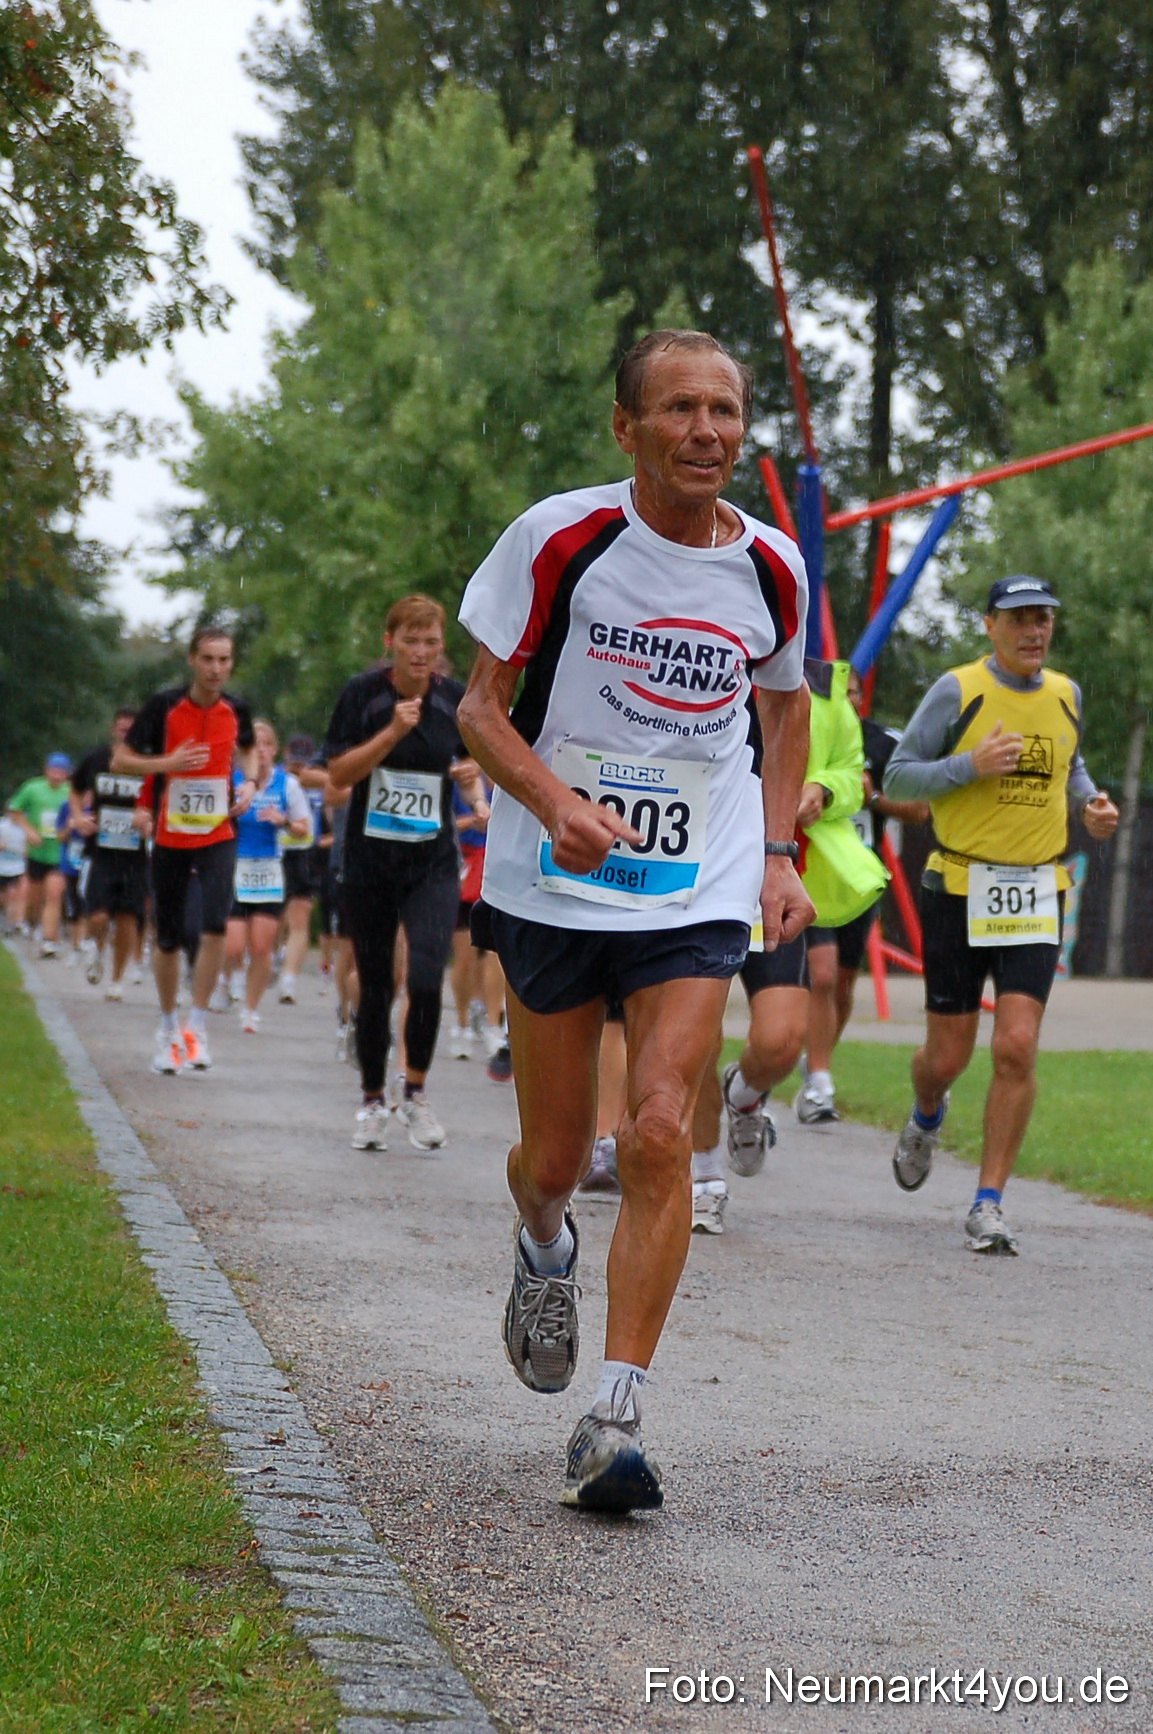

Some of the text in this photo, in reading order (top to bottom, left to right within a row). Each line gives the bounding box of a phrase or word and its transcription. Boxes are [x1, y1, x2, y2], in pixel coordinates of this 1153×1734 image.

[586, 647, 651, 671] Autohaus
[589, 622, 733, 670] GERHART
[648, 662, 738, 693] JÄNIG
[598, 684, 738, 737] Das sportliche Autohaus
[599, 762, 666, 783] BOCK
[180, 794, 215, 814] 370
[375, 787, 433, 818] 2220
[987, 886, 1037, 915] 301
[985, 922, 1042, 934] Alexander
